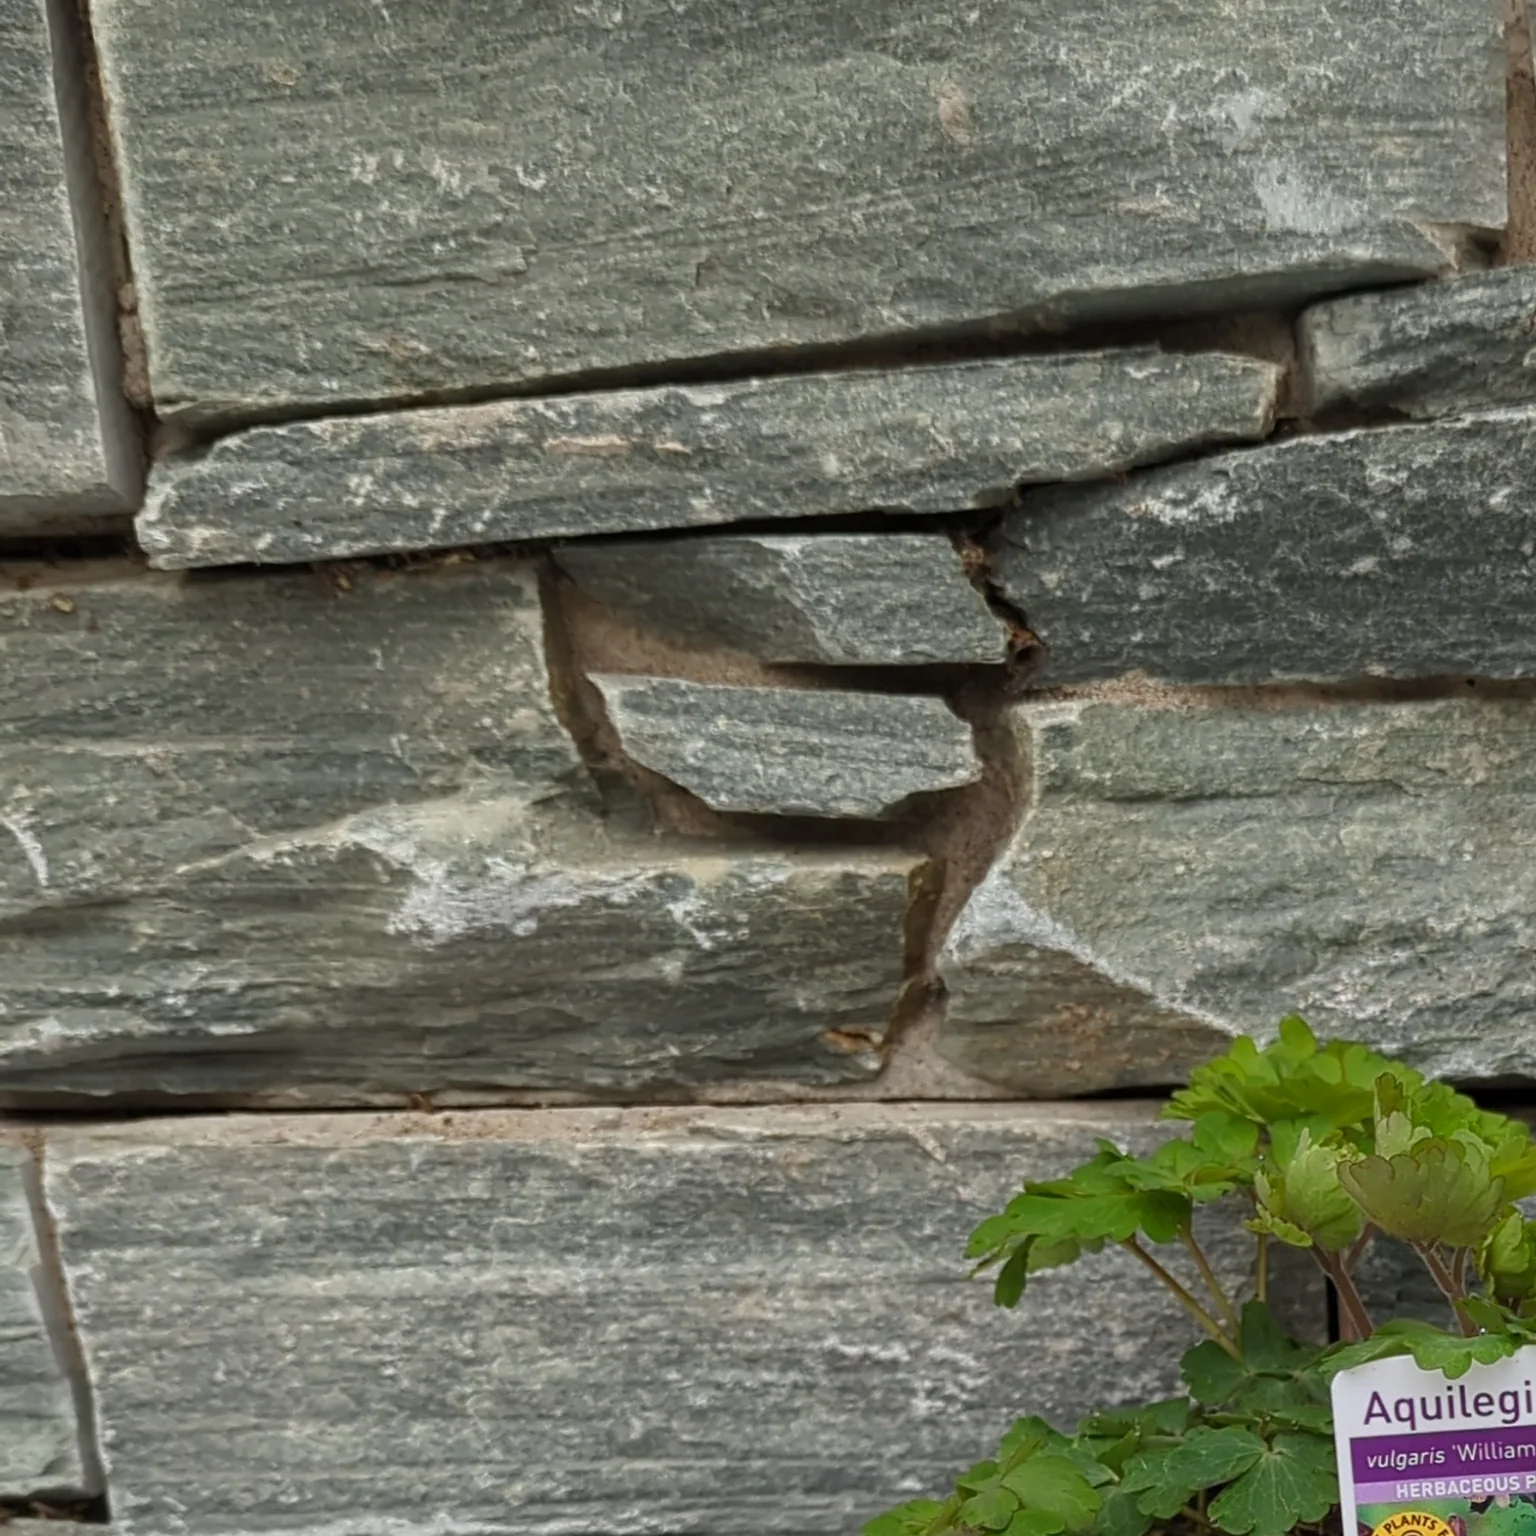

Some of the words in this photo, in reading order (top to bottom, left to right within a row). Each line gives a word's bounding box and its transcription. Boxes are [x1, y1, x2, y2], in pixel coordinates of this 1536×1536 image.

[1366, 1446, 1446, 1470] vulgaris
[1452, 1441, 1536, 1463] 'William
[1396, 1475, 1521, 1499] HERBACEOUS
[1383, 1514, 1439, 1534] PLANTS
